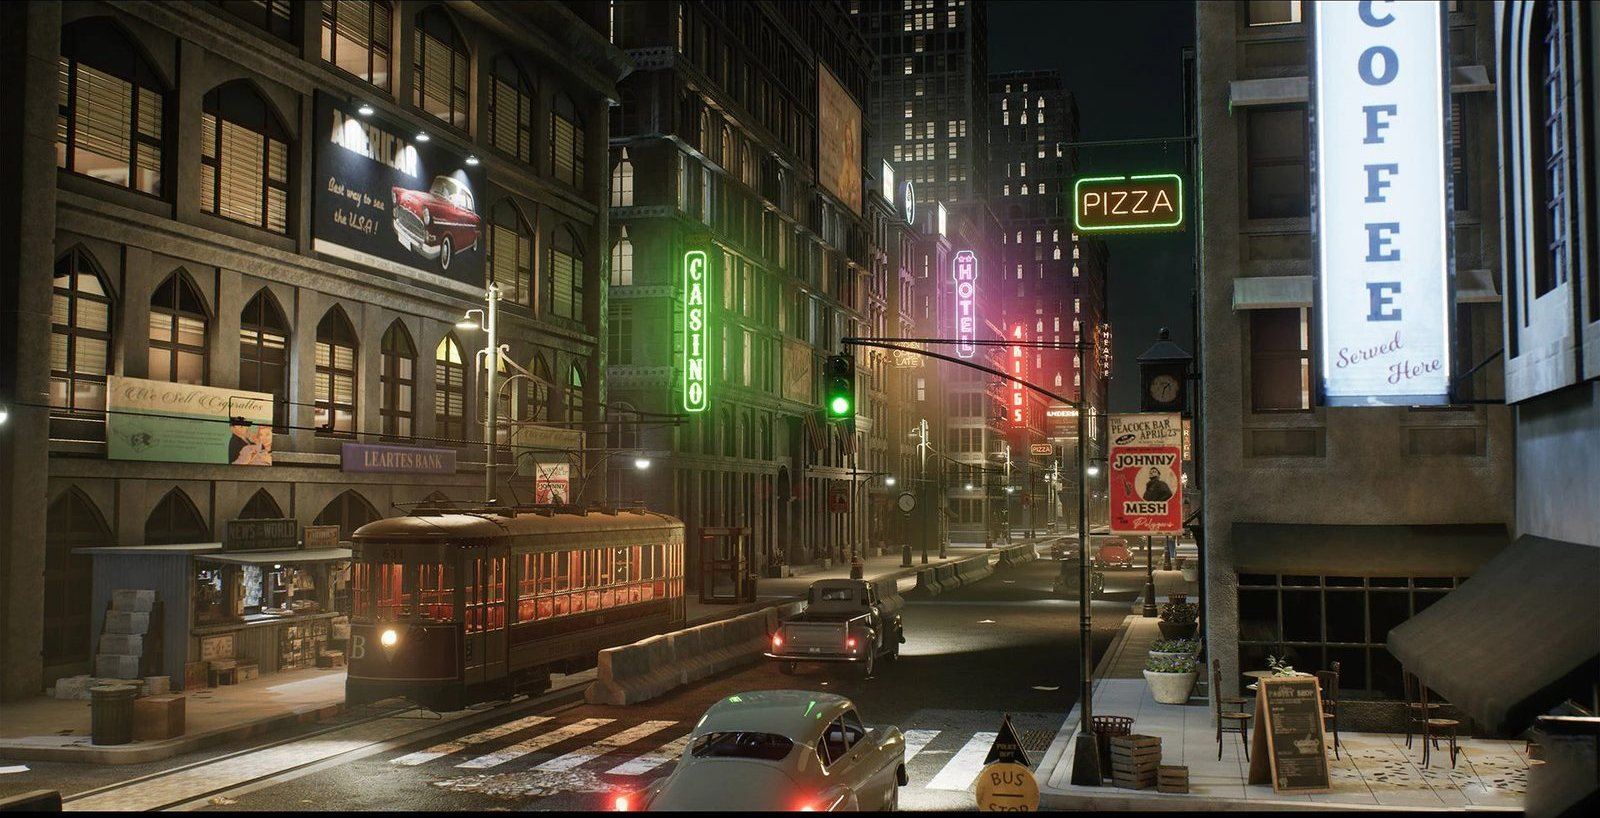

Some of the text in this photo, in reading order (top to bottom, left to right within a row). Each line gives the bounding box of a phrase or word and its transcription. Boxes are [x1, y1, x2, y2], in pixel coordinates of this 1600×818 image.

[331, 108, 418, 178] AMERICAN
[1357, 0, 1402, 322] COFFEE
[346, 188, 362, 208] way
[363, 191, 372, 205] to
[373, 198, 385, 211] see
[1083, 189, 1174, 216] PIZZA
[333, 208, 347, 226] the
[959, 263, 973, 352] HOTEL
[688, 258, 704, 405] CASINO
[1102, 323, 1110, 377] THEATRE
[1336, 330, 1404, 369] Served
[1387, 359, 1442, 384] Here
[1111, 419, 1171, 434] PEACOCK BAR
[1140, 429, 1168, 440] APRIL
[364, 451, 443, 469] LEARTES BANK
[1114, 454, 1175, 469] JOHNNY
[1125, 503, 1167, 514] MESH
[263, 521, 295, 538] WORLD
[990, 771, 1025, 787] BUS
